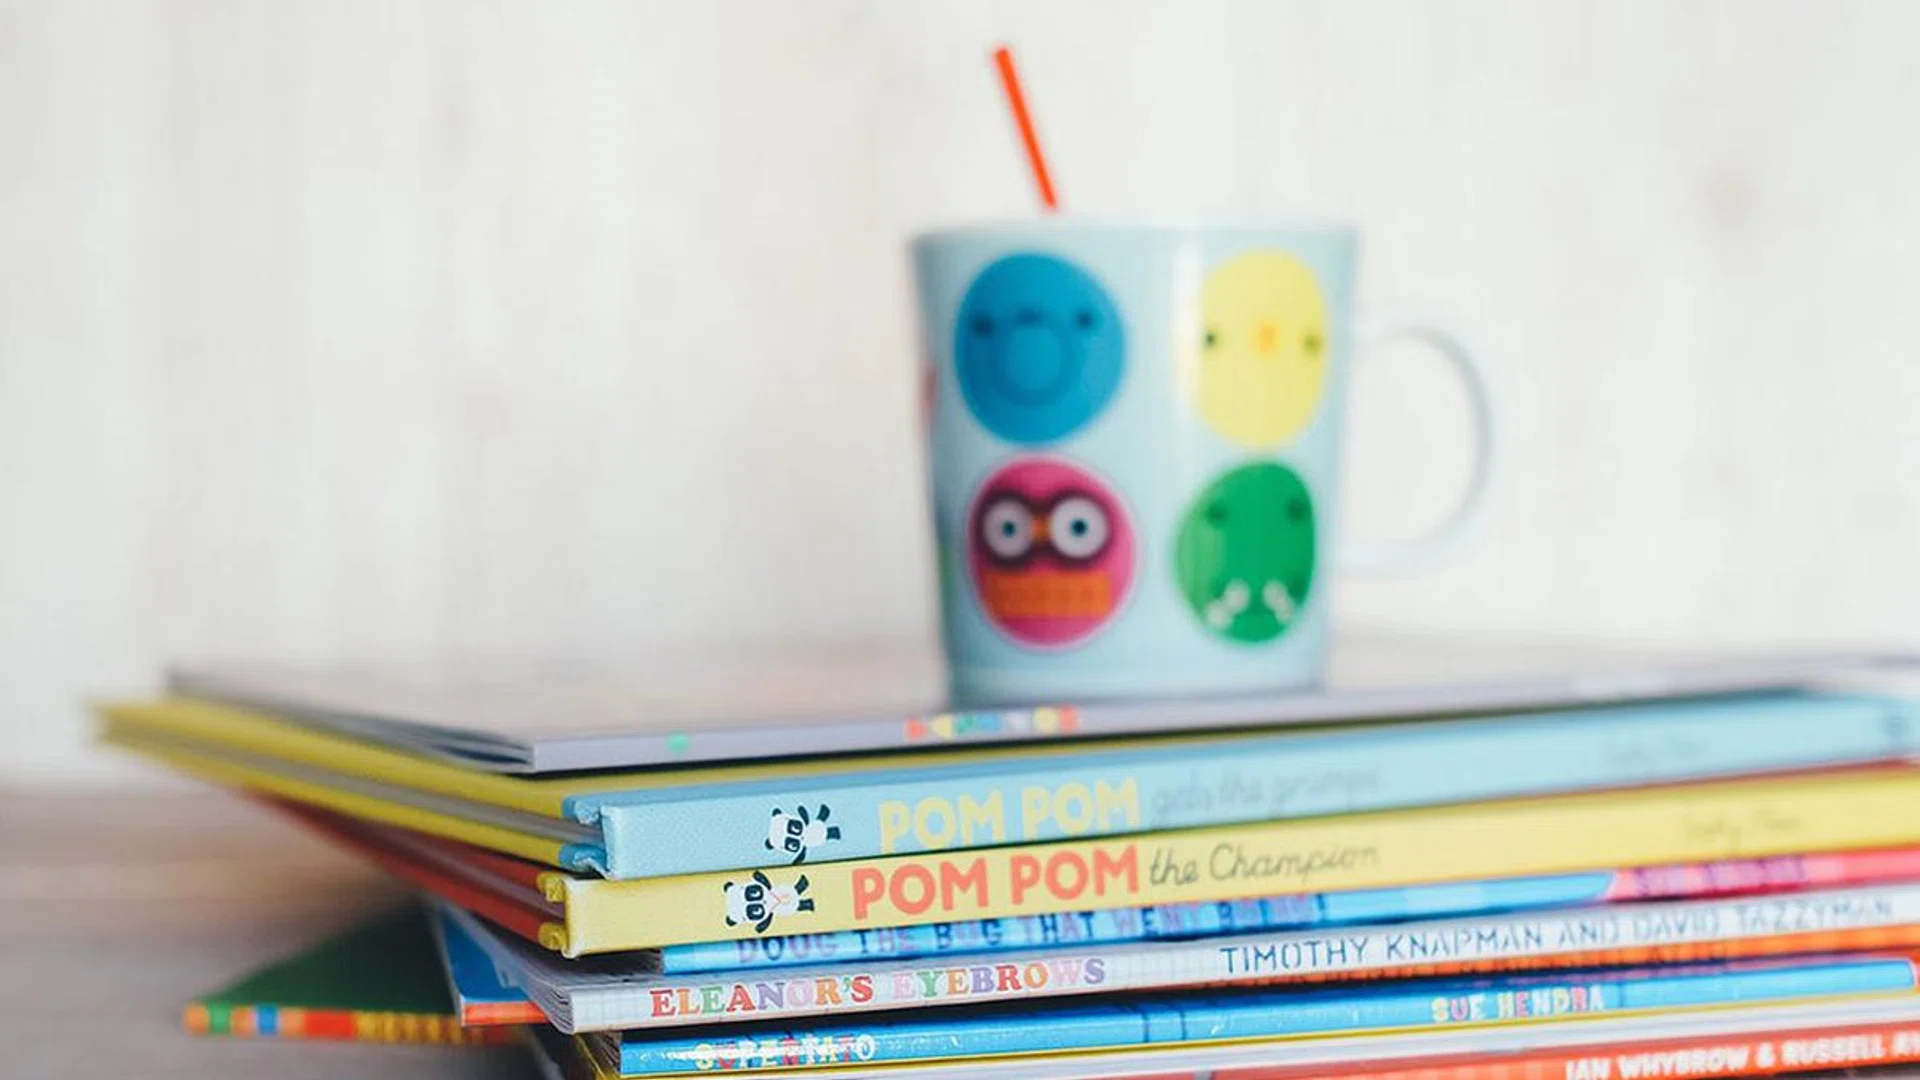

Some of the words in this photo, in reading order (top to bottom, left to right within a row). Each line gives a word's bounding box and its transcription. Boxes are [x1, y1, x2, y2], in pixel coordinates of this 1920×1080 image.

[879, 794, 1003, 853] POM
[1021, 777, 1141, 840] POM
[851, 858, 990, 920] POM
[1009, 843, 1139, 905] POM
[1150, 846, 1199, 886] the
[1209, 841, 1380, 885] Champion
[650, 974, 874, 1018] ELEANOR'S
[893, 957, 1106, 1000] EYEBROWS
[1219, 935, 1369, 974] TIMOTHY
[1386, 921, 1543, 962] KNAPMAN
[1557, 918, 1620, 950] AND
[1633, 910, 1720, 943] DAVID
[1738, 897, 1894, 935] TAZZYMAN
[735, 937, 837, 964] DOUG
[857, 927, 918, 956] THE
[935, 918, 1001, 951] BUG
[1023, 910, 1096, 944] THAT
[1431, 993, 1488, 1023] SUE
[1497, 984, 1605, 1020] HENDRA
[1564, 1056, 1611, 1080] IAN
[1616, 1045, 1750, 1079] WHYBROW
[1754, 1040, 1776, 1068] &
[1780, 1033, 1885, 1066] RUSSELL
